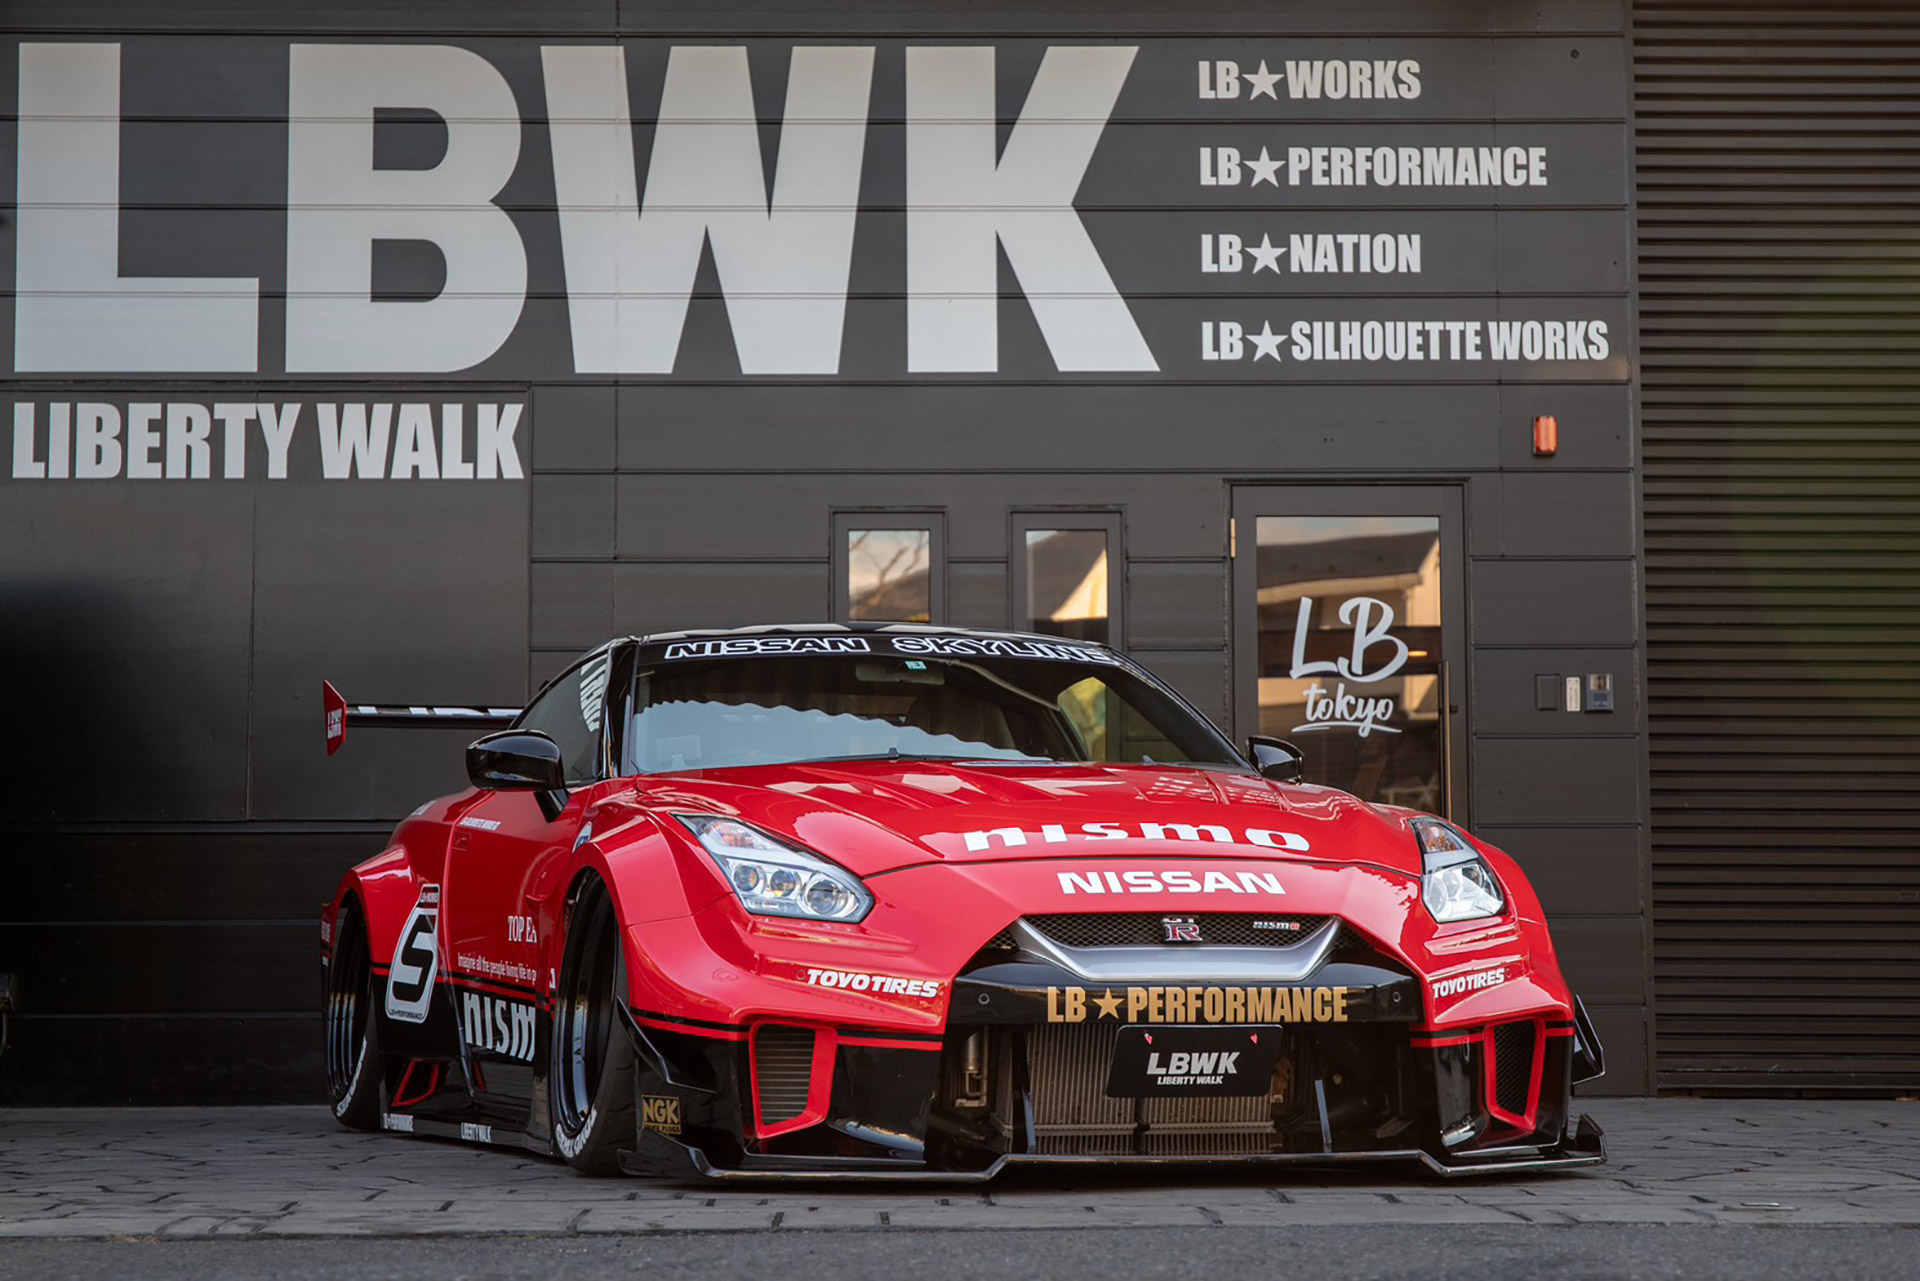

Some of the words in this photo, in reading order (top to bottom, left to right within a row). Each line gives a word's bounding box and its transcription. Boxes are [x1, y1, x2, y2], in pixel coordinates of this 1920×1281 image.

[14, 42, 1160, 374] LBWK
[1488, 320, 1609, 361] WORKS
[12, 402, 302, 480] LIBERTY
[317, 402, 524, 480] WALK
[664, 637, 871, 659] NISSAN
[891, 637, 1121, 667] SKYLINE
[1289, 596, 1409, 683] LB
[1303, 682, 1394, 738] tokyo
[963, 822, 1311, 852] nismo
[1057, 871, 1287, 895] NISSAN
[508, 916, 524, 942] TOP
[1253, 921, 1301, 930] nismo
[1146, 1051, 1240, 1075] LBWK
[1157, 1076, 1195, 1085] LIBERTY
[1196, 1075, 1223, 1085] WALK
[643, 1098, 680, 1124] NGK
